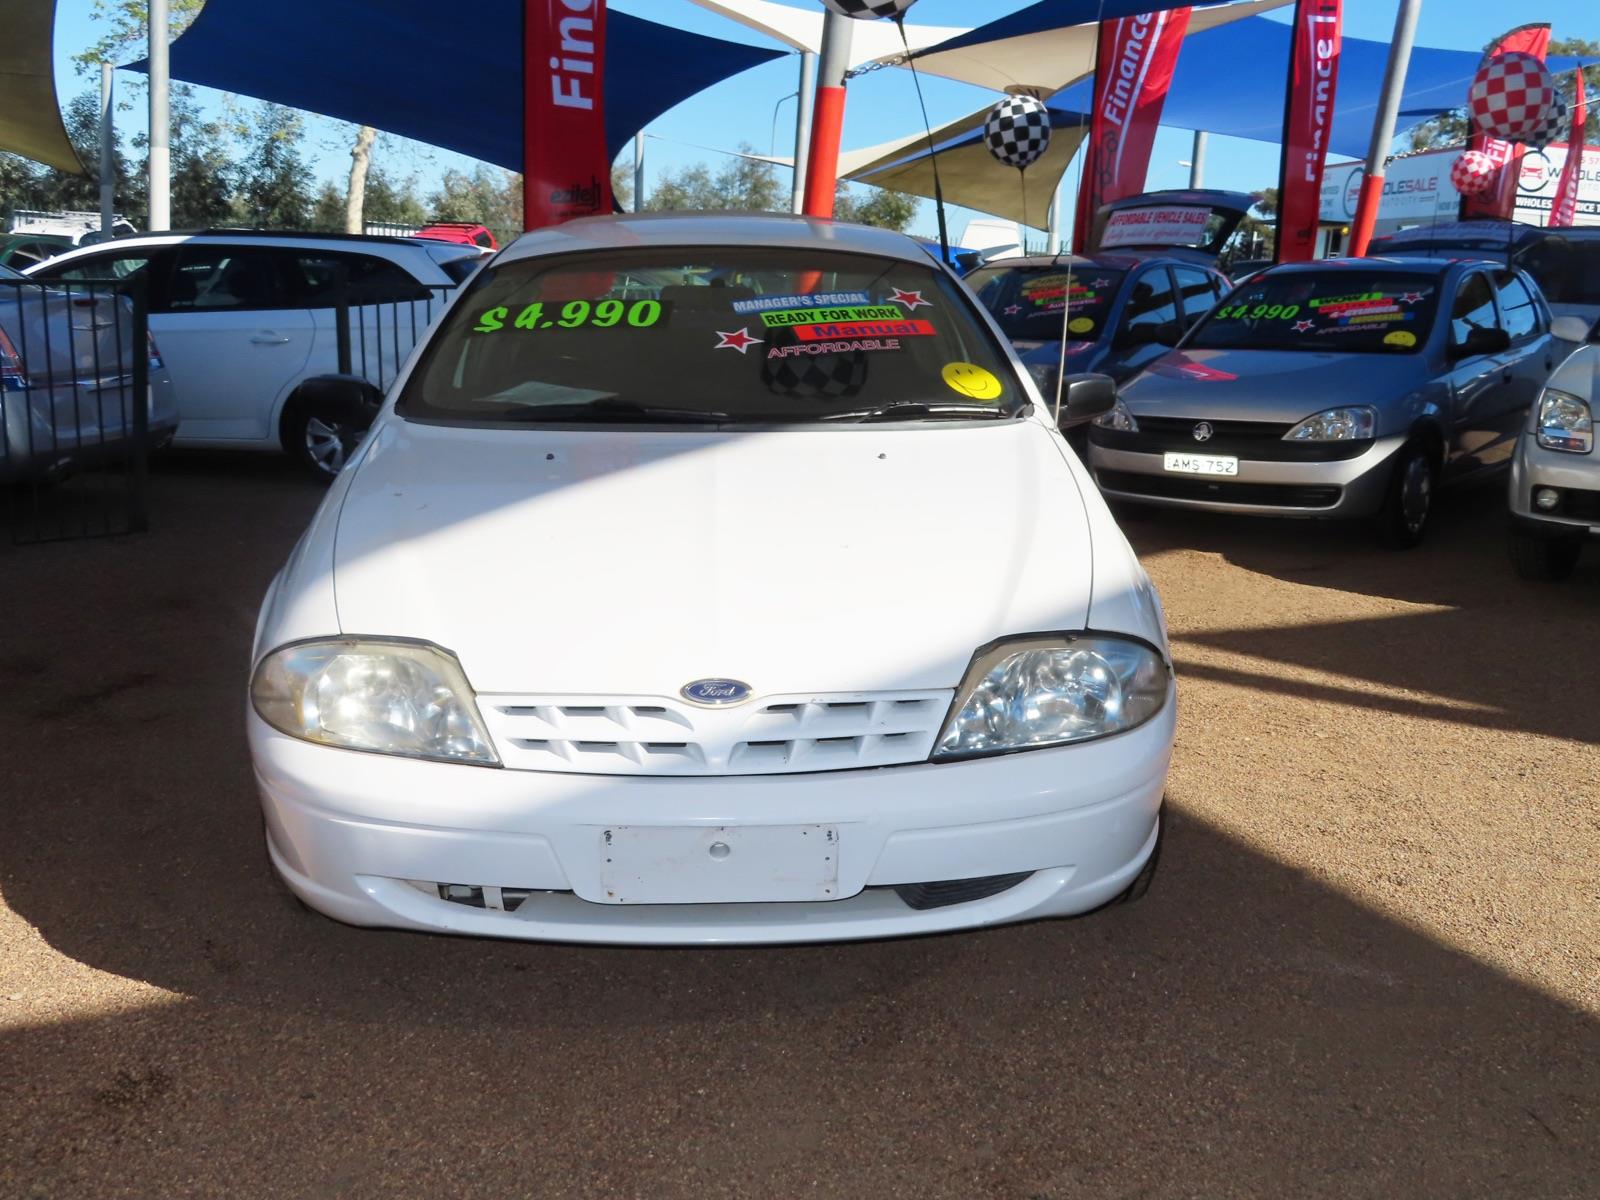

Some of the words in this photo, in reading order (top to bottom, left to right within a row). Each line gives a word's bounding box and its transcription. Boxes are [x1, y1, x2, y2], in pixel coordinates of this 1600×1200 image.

[1104, 12, 1153, 126] Finance
[733, 296, 811, 312] MANAGER'S
[813, 292, 868, 306] SPECIAL
[473, 300, 662, 333] $4.990
[764, 312, 816, 327] READY
[821, 309, 853, 323] FOR
[854, 305, 901, 320] WORK
[814, 322, 921, 338] Manual
[768, 339, 901, 359] AFFORDABLE
[1172, 458, 1201, 471] AMS
[699, 683, 736, 696] Ford
